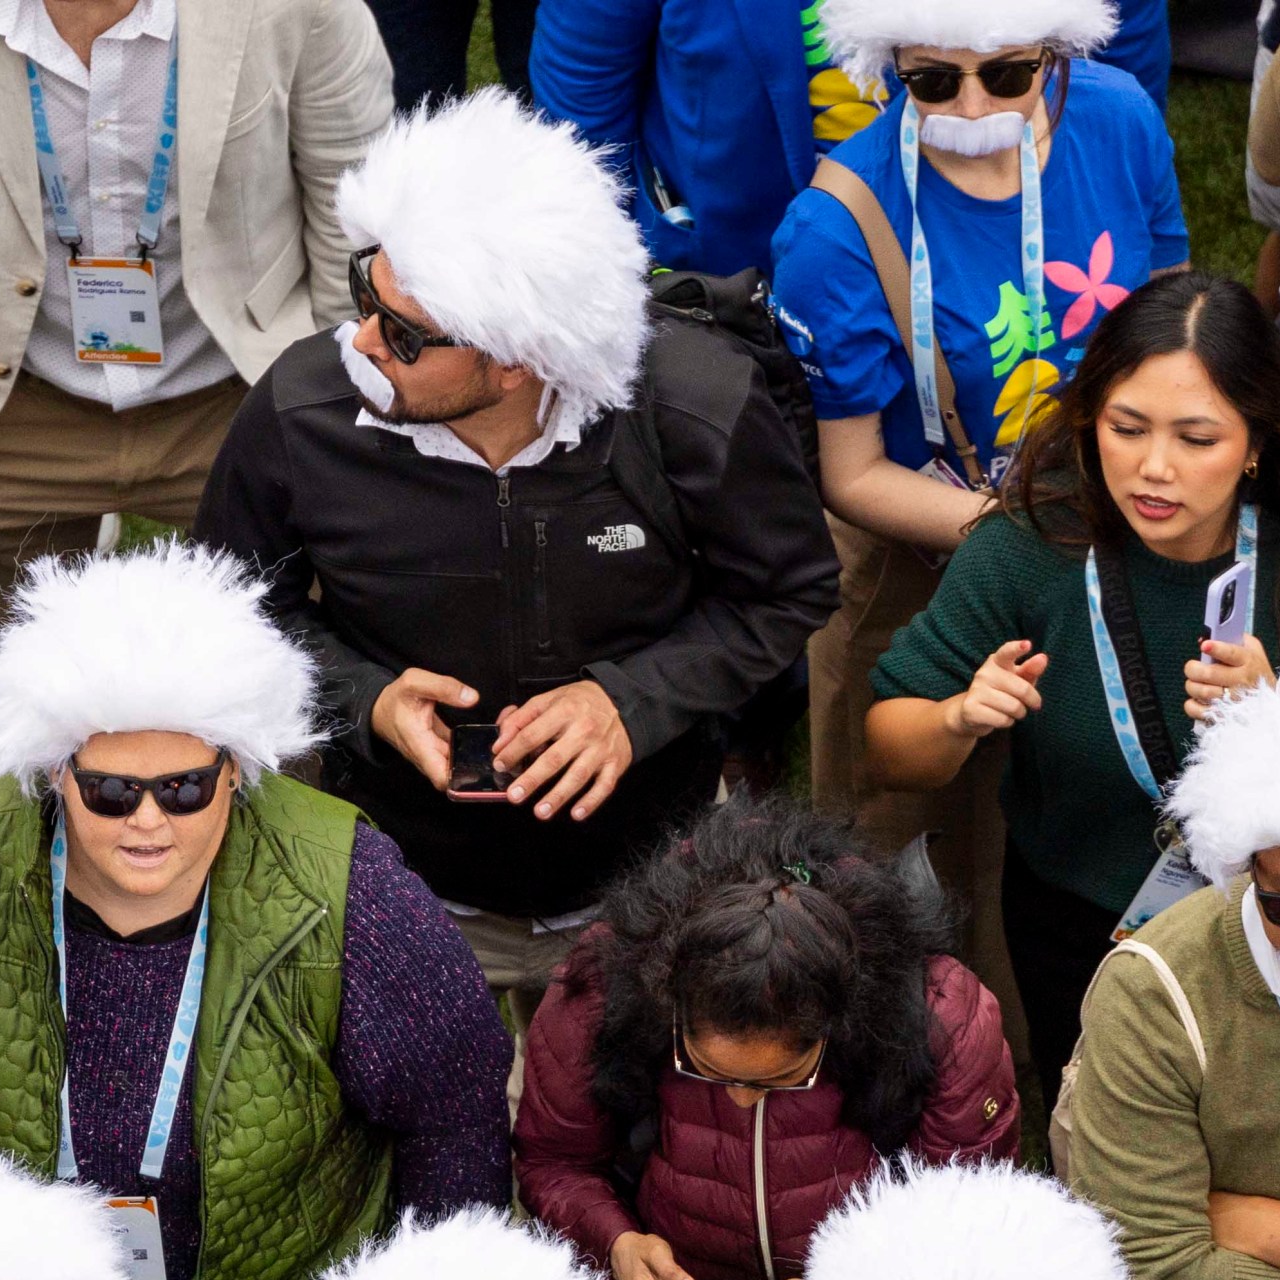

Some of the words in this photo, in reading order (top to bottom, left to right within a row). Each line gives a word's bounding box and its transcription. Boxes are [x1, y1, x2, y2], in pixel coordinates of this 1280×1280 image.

[77, 279, 123, 288] Federico
[83, 352, 128, 360] Attendee
[604, 525, 625, 536] THE
[587, 533, 625, 545] NORTH
[598, 542, 627, 553] FACE
